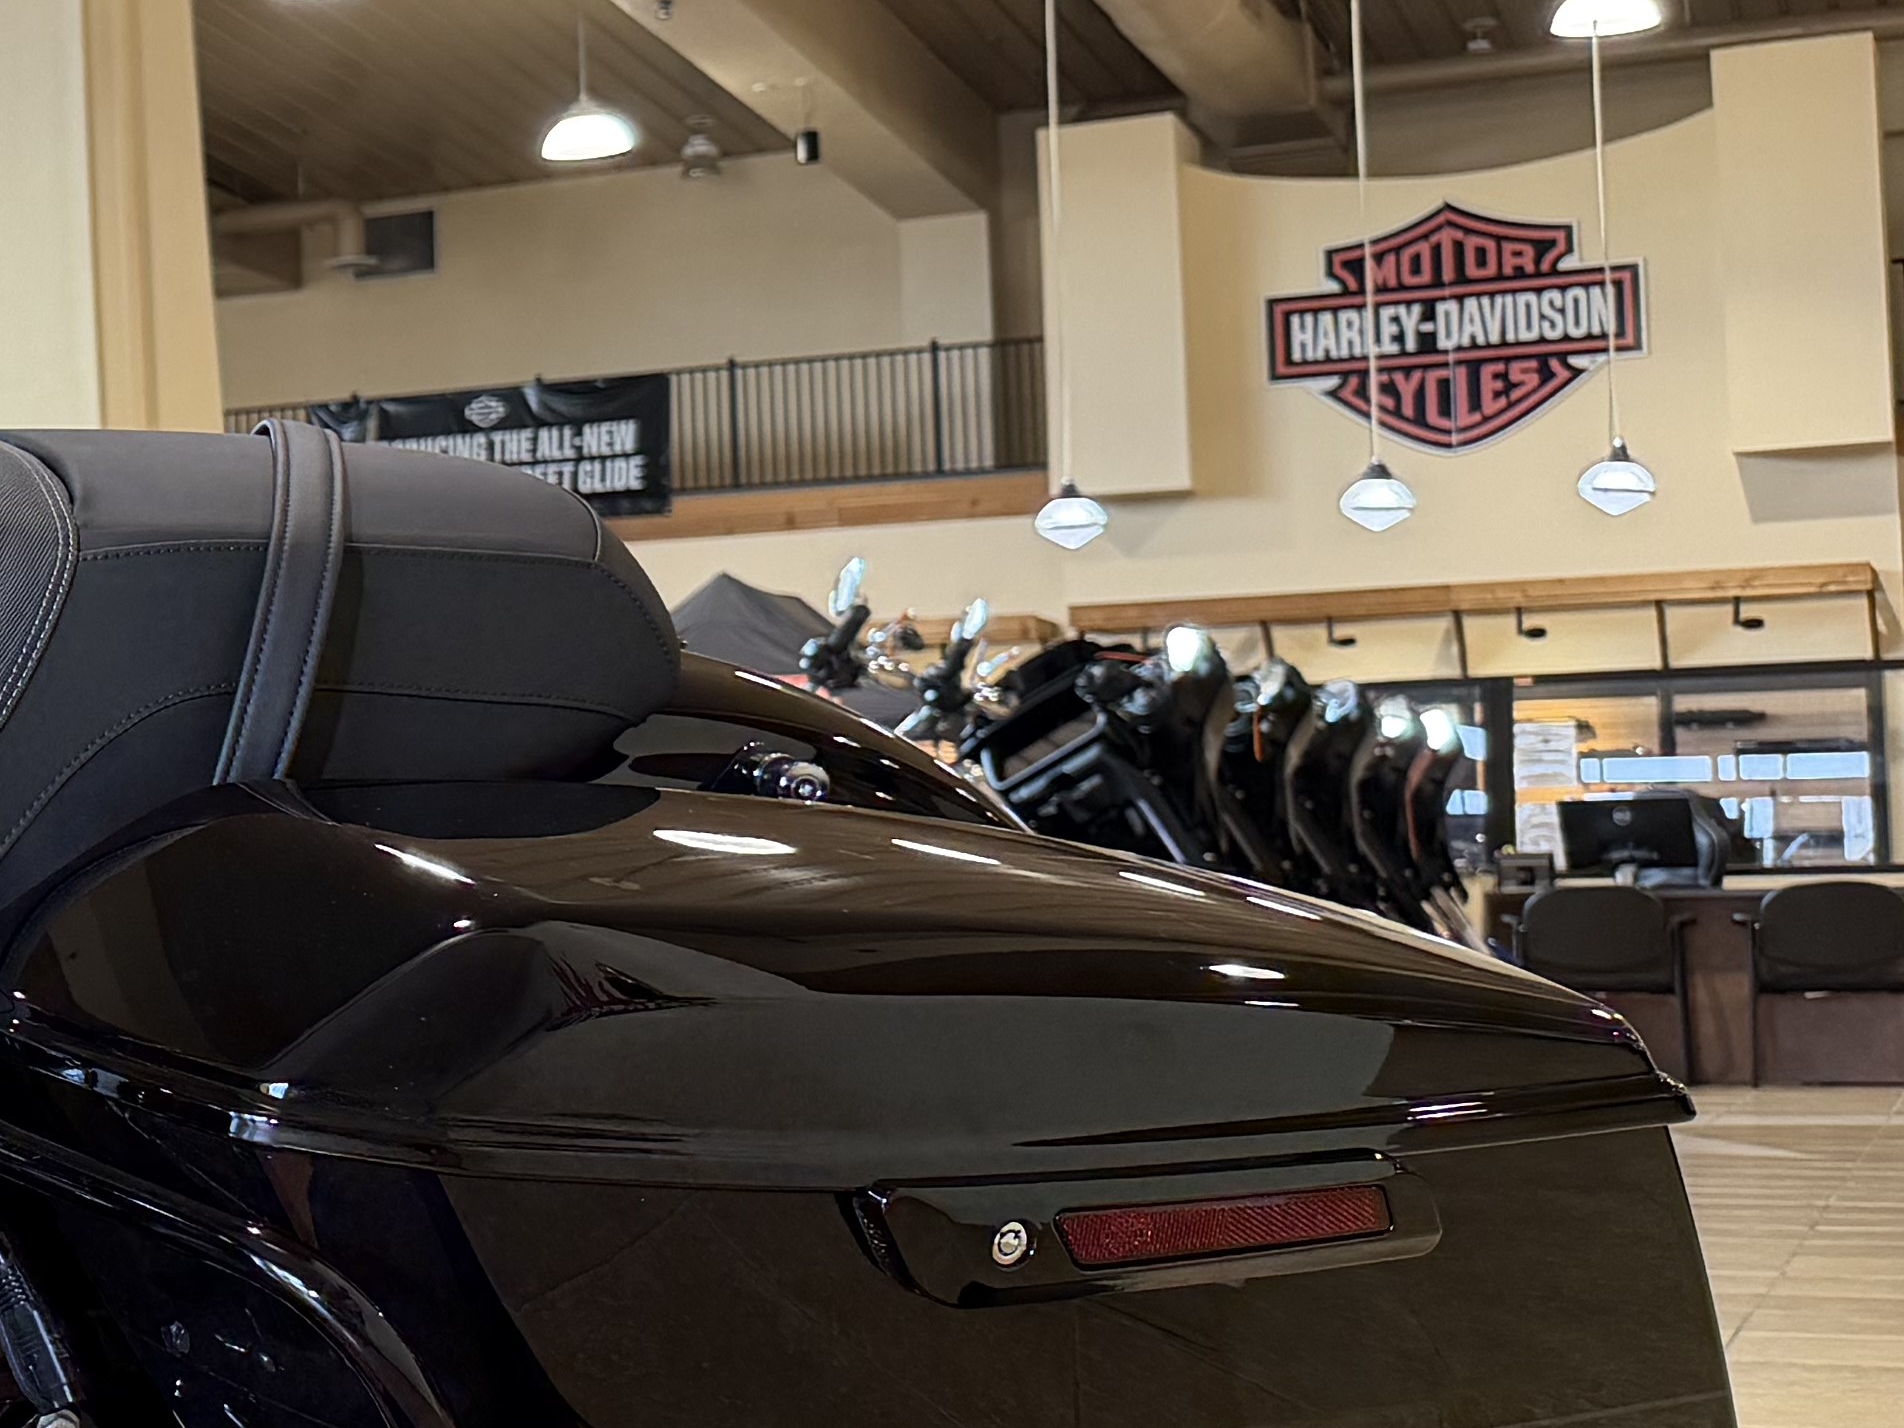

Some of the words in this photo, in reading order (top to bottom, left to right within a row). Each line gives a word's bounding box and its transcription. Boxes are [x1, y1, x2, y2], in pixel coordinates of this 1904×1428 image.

[1369, 225, 1536, 290] MOTOR
[1291, 284, 1616, 363] HARLEY-DAVIDSON
[1367, 357, 1541, 430] CYCLES
[490, 426, 534, 464] THE
[535, 418, 640, 461] ALL-NEW
[576, 455, 645, 494] GLIDE
